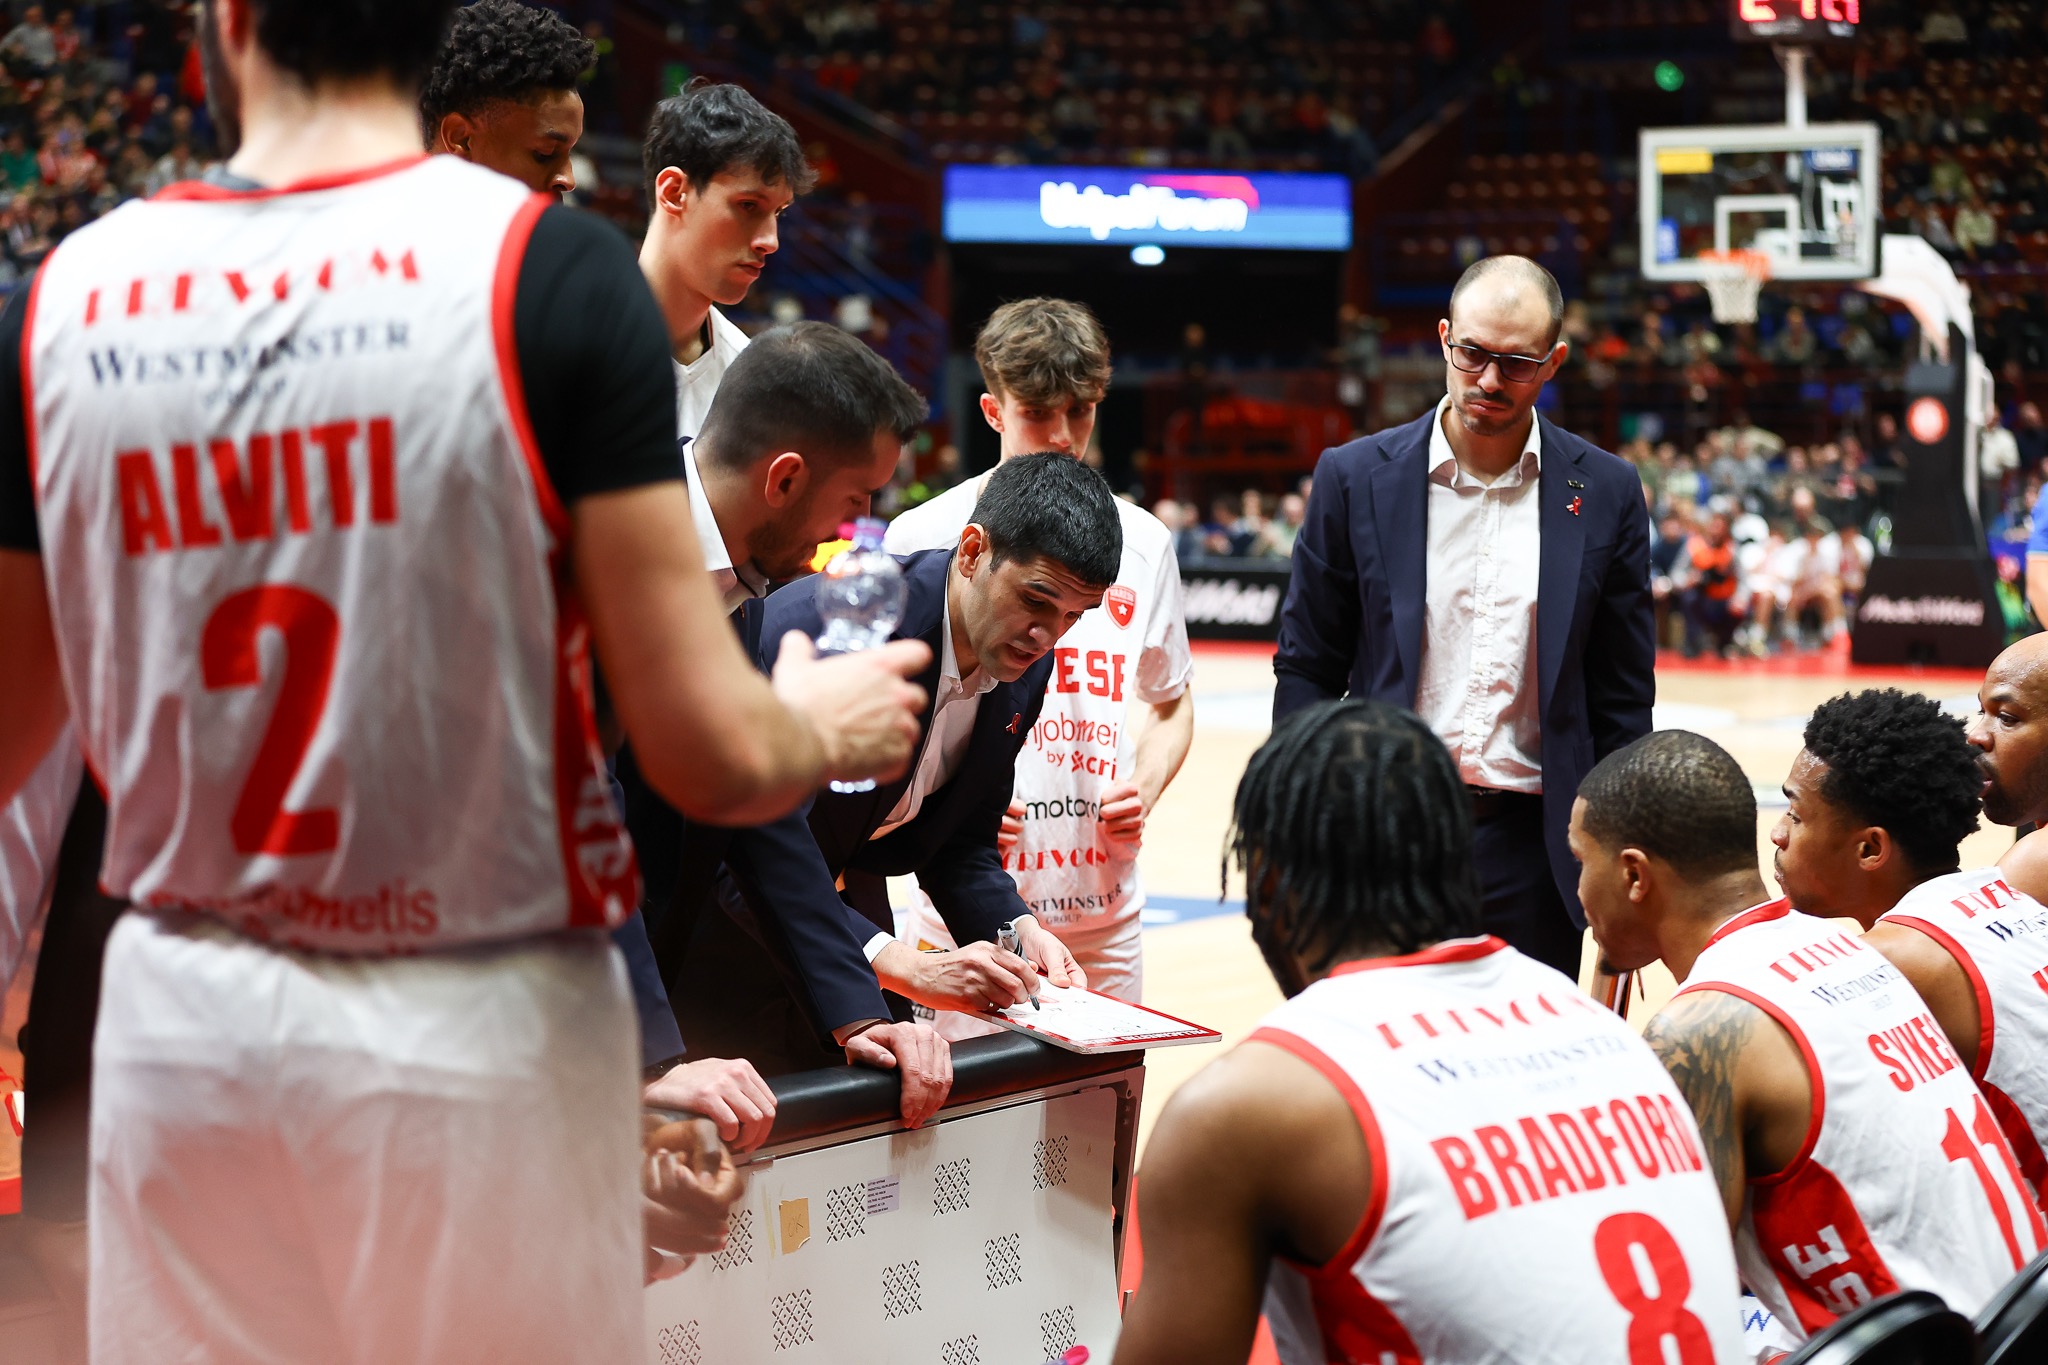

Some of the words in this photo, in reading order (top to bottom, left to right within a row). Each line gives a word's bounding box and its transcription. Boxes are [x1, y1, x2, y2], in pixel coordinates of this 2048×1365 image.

[117, 417, 397, 557] ALVITI
[201, 583, 343, 856] 2
[1040, 647, 1126, 702] ESE
[1046, 750, 1066, 768] by
[1026, 882, 1123, 913] STMINSTER
[1046, 913, 1082, 925] GROUP
[1430, 1094, 1703, 1222] BRADFORD
[1940, 1093, 2048, 1272] 11
[1593, 1211, 1718, 1365] 8
